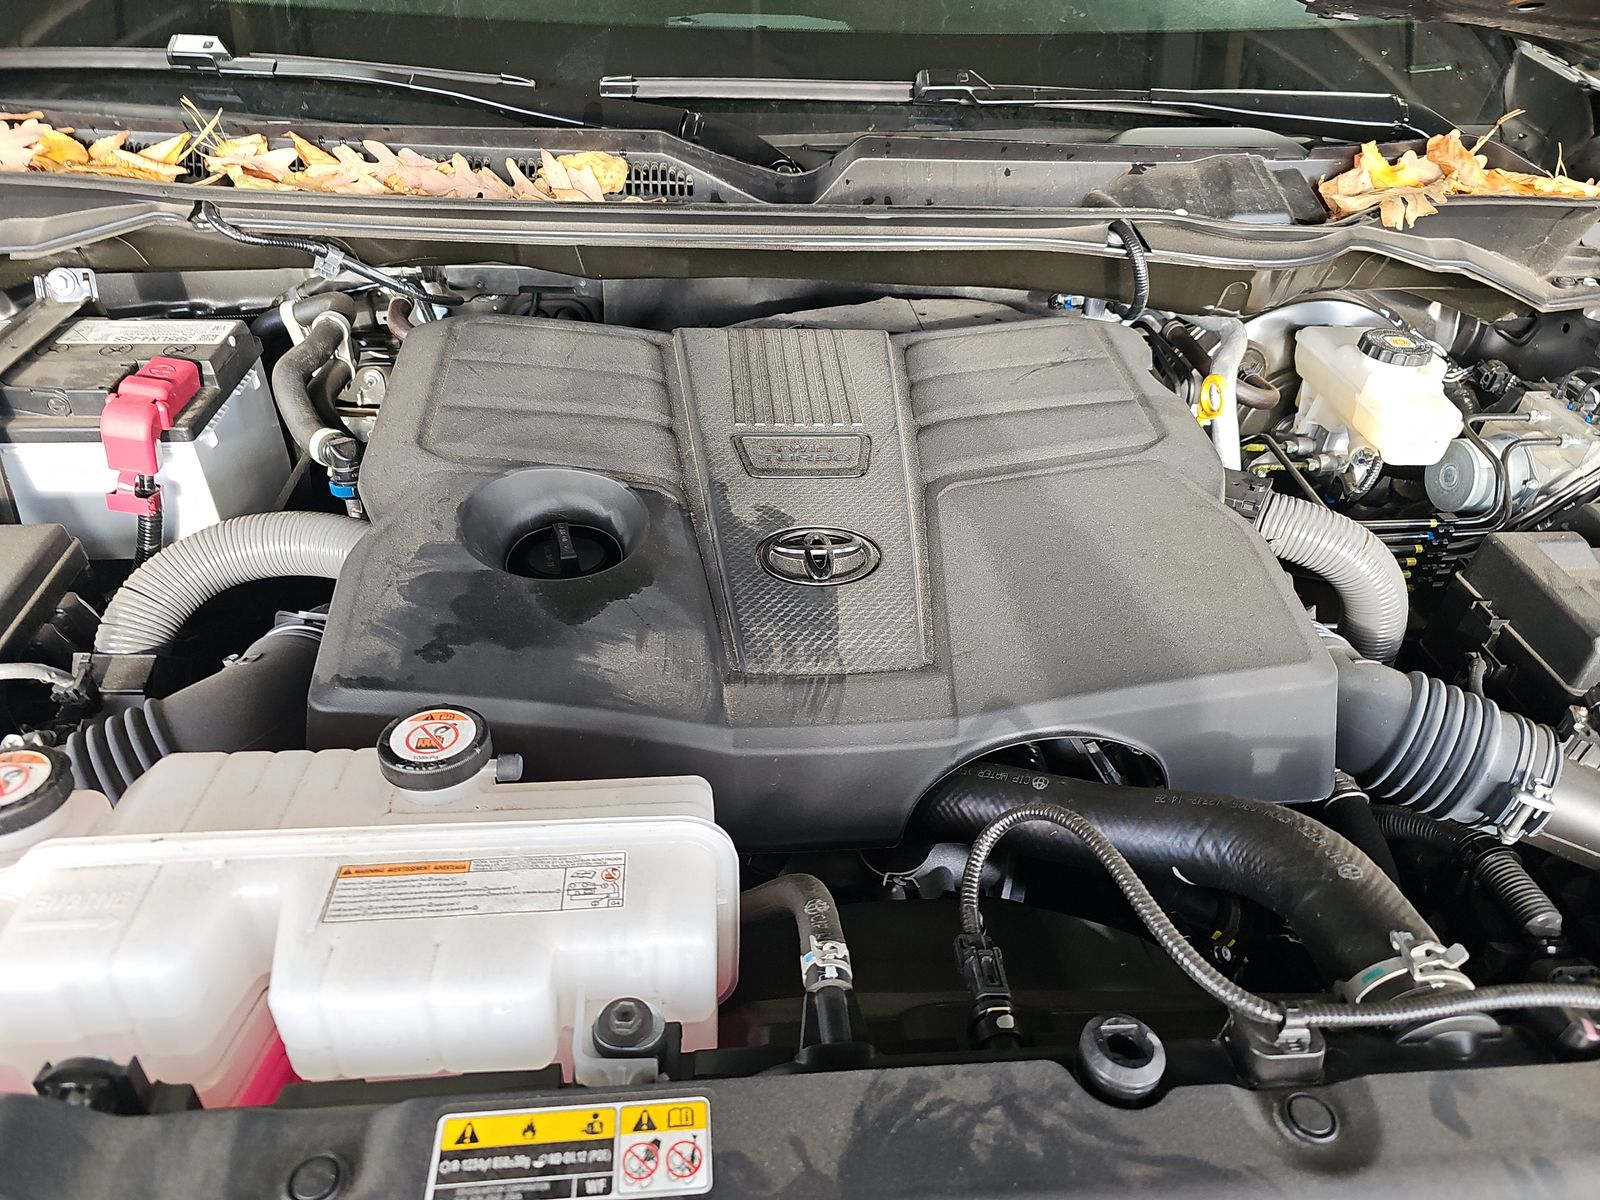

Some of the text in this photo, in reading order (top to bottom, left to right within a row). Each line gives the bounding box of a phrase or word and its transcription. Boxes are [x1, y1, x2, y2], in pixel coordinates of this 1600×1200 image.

[768, 444, 834, 452] TWIN
[759, 453, 852, 461] TURBO
[978, 769, 1008, 781] WATER
